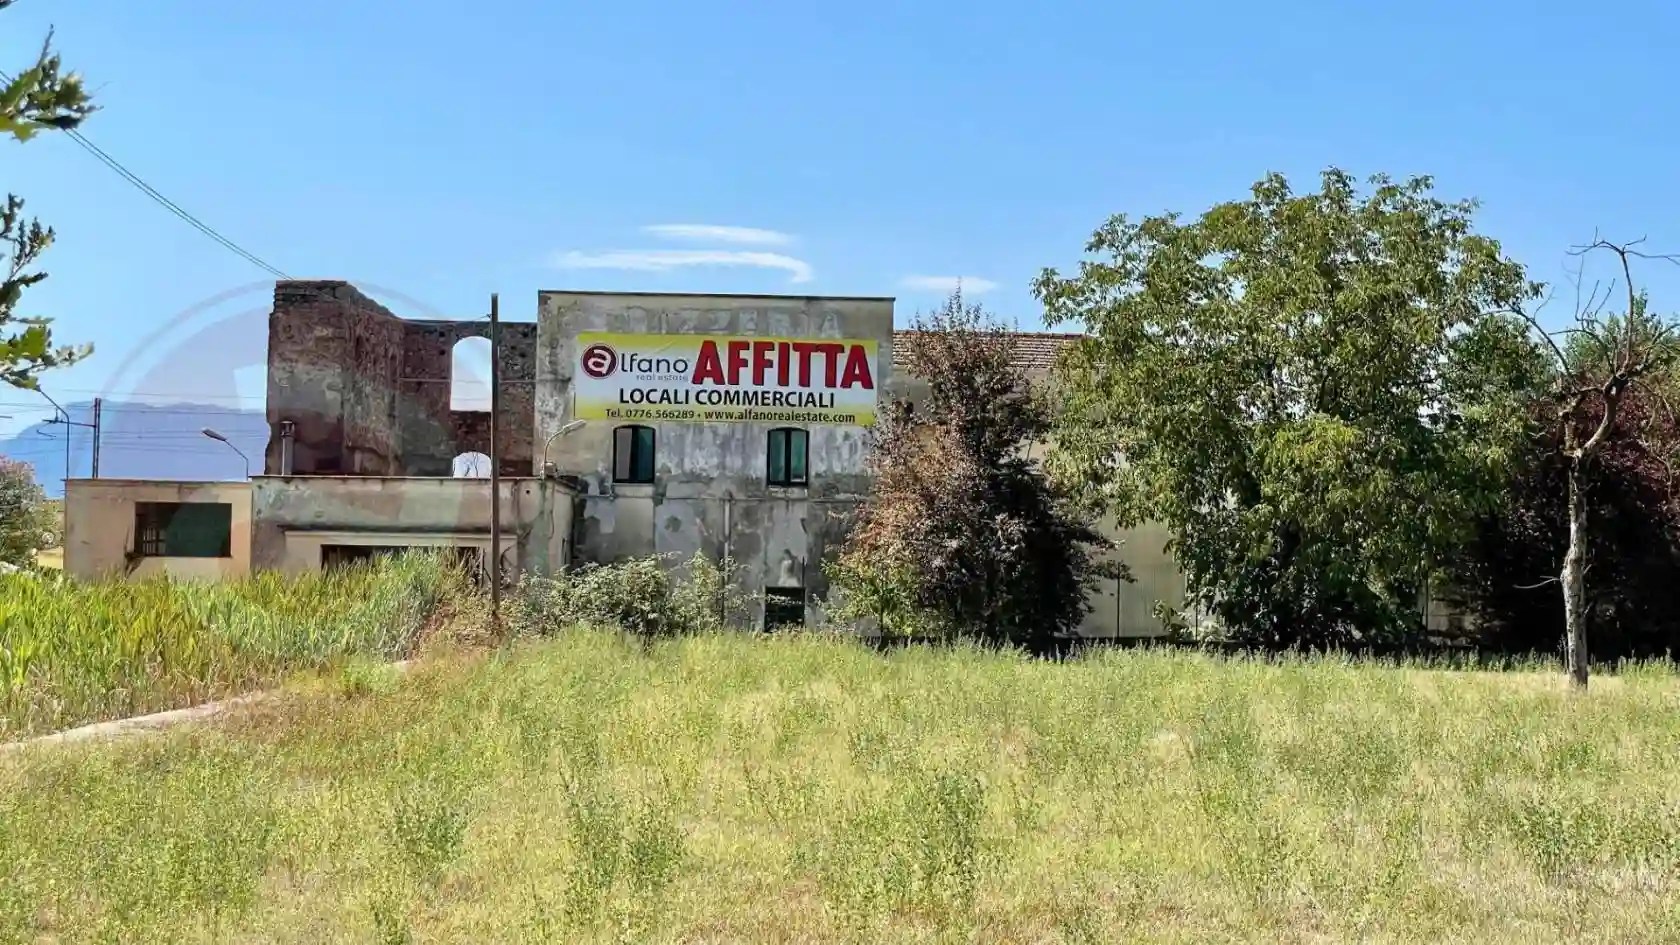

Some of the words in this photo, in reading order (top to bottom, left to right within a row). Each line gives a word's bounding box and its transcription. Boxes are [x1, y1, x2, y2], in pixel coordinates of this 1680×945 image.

[691, 340, 874, 389] AFFITTA
[636, 373, 656, 381] real
[620, 388, 689, 404] LOCALI
[695, 390, 834, 408] COMMERCIALI
[606, 409, 623, 418] Tel.
[626, 410, 694, 419] 0776.566289
[705, 409, 855, 423] www.alfanorealestate.com
